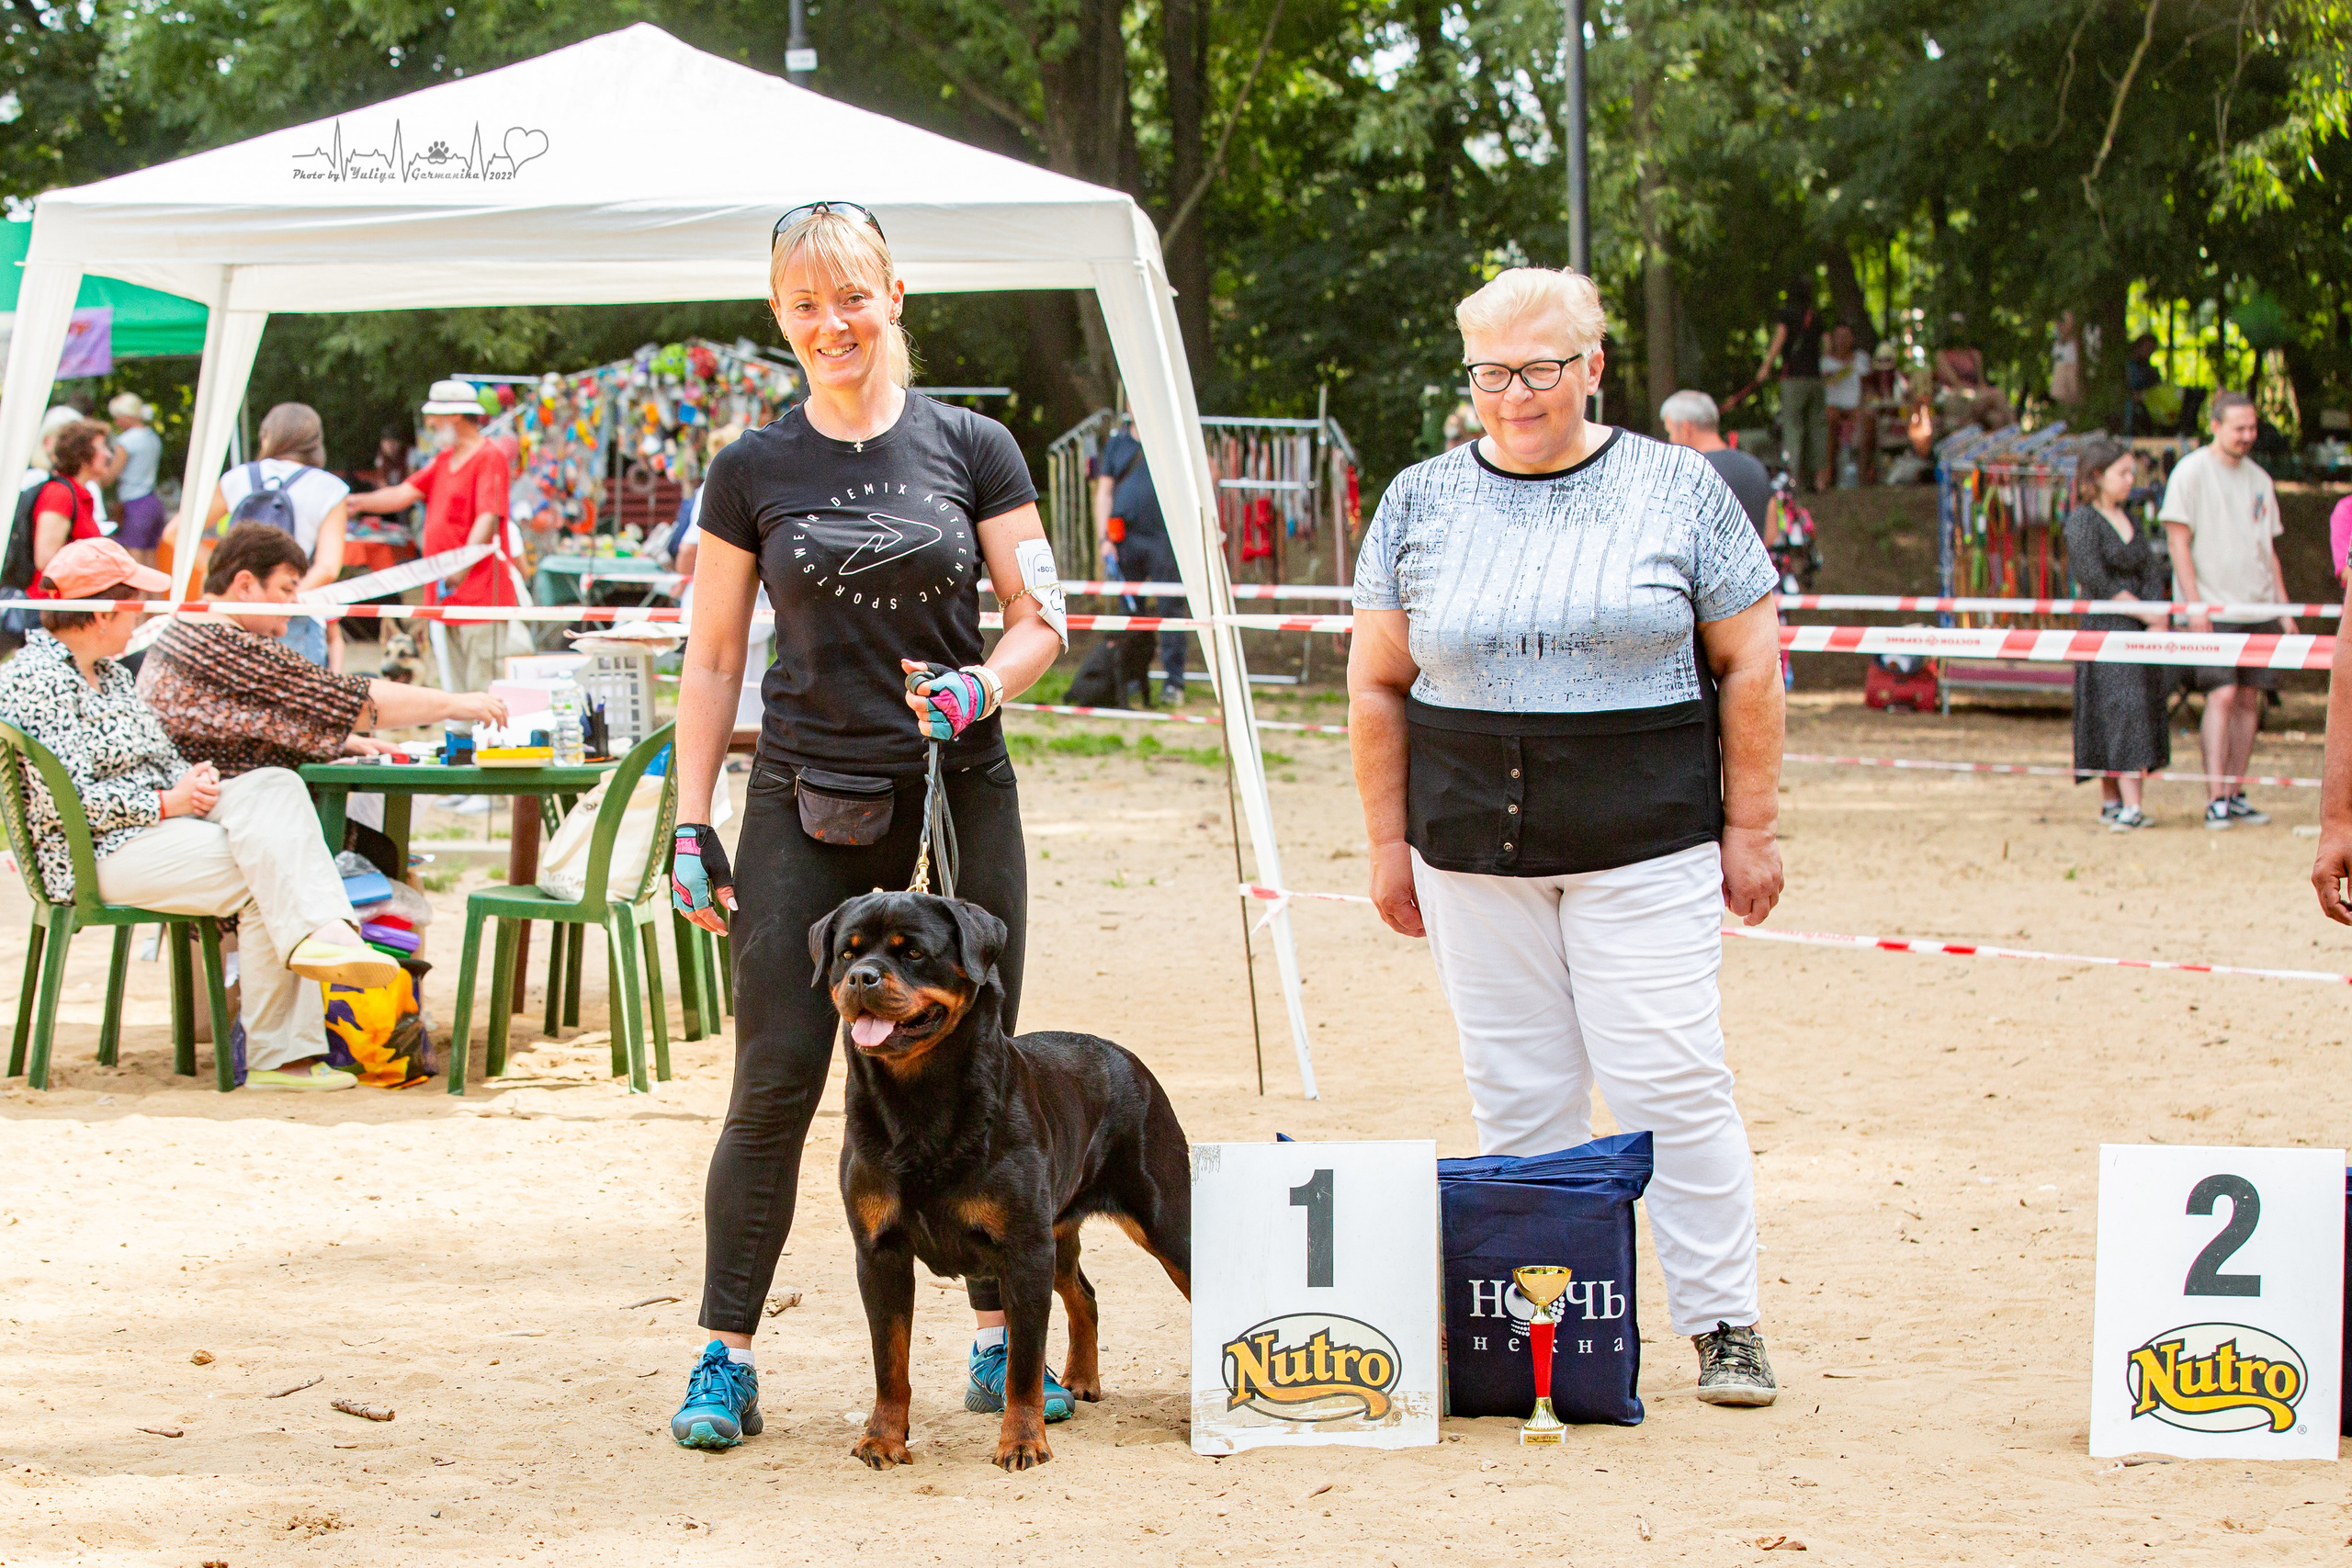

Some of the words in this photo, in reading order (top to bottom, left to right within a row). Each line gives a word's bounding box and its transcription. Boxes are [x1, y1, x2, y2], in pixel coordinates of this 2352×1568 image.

[830, 482, 907, 507] DEMIX
[793, 513, 898, 610] SPORTSWEAR
[919, 493, 967, 603] AUTHENTIC
[2124, 642, 2163, 650] СЕРВИС
[2179, 644, 2221, 652] ВОСТОК
[1289, 1168, 1335, 1289] 1
[2183, 1173, 2262, 1298] 2
[1225, 1331, 1393, 1417] Nutro
[1473, 1336, 1625, 1355] нена
[2130, 1340, 2298, 1431] Nutro
